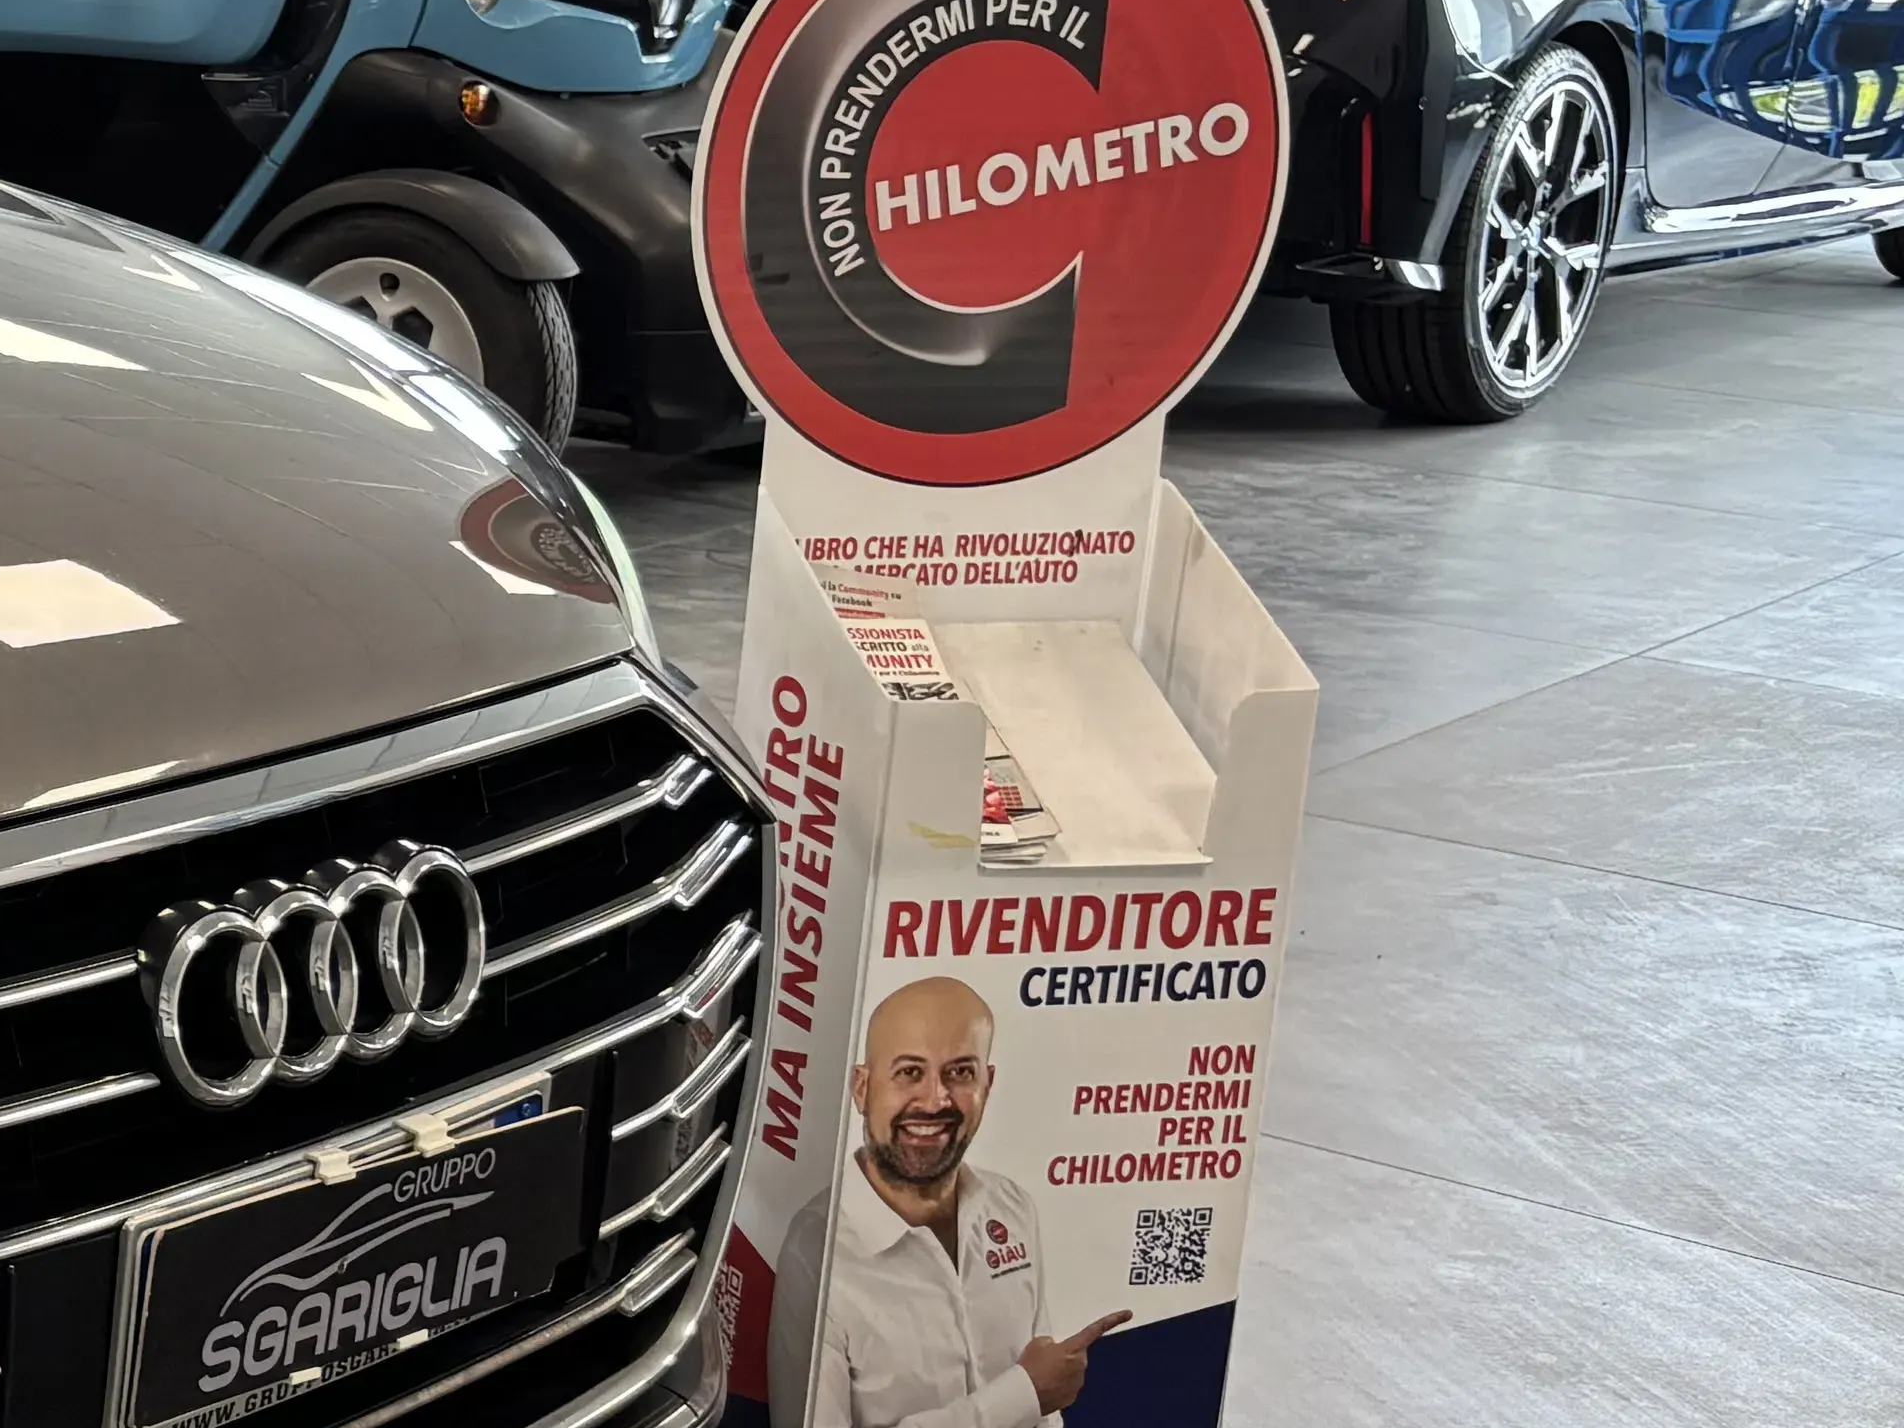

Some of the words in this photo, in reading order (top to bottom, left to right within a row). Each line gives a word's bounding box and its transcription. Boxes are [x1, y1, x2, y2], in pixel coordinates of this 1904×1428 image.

[818, 191, 866, 277] NON
[1058, 5, 1090, 50] IL
[796, 535, 859, 561] IBRO
[864, 535, 908, 560] CHE
[913, 535, 944, 559] HA
[955, 529, 1135, 558] RIVOLUZIONATO
[963, 559, 1078, 585] DELL'AUTO
[777, 733, 844, 1034] INSIEME
[883, 887, 1277, 958] RIVENDITORE
[1019, 959, 1267, 1008] CERTIFICATO
[1188, 1044, 1256, 1077] NON
[761, 1047, 809, 1162] MA
[1072, 1080, 1251, 1116] PRENDERMI
[1157, 1116, 1214, 1147] PER
[1221, 1114, 1247, 1144] IL
[393, 1147, 497, 1203] GRUPPO
[1047, 1149, 1243, 1186] CHILOMETRO
[198, 1236, 508, 1393] SGARIGLIA
